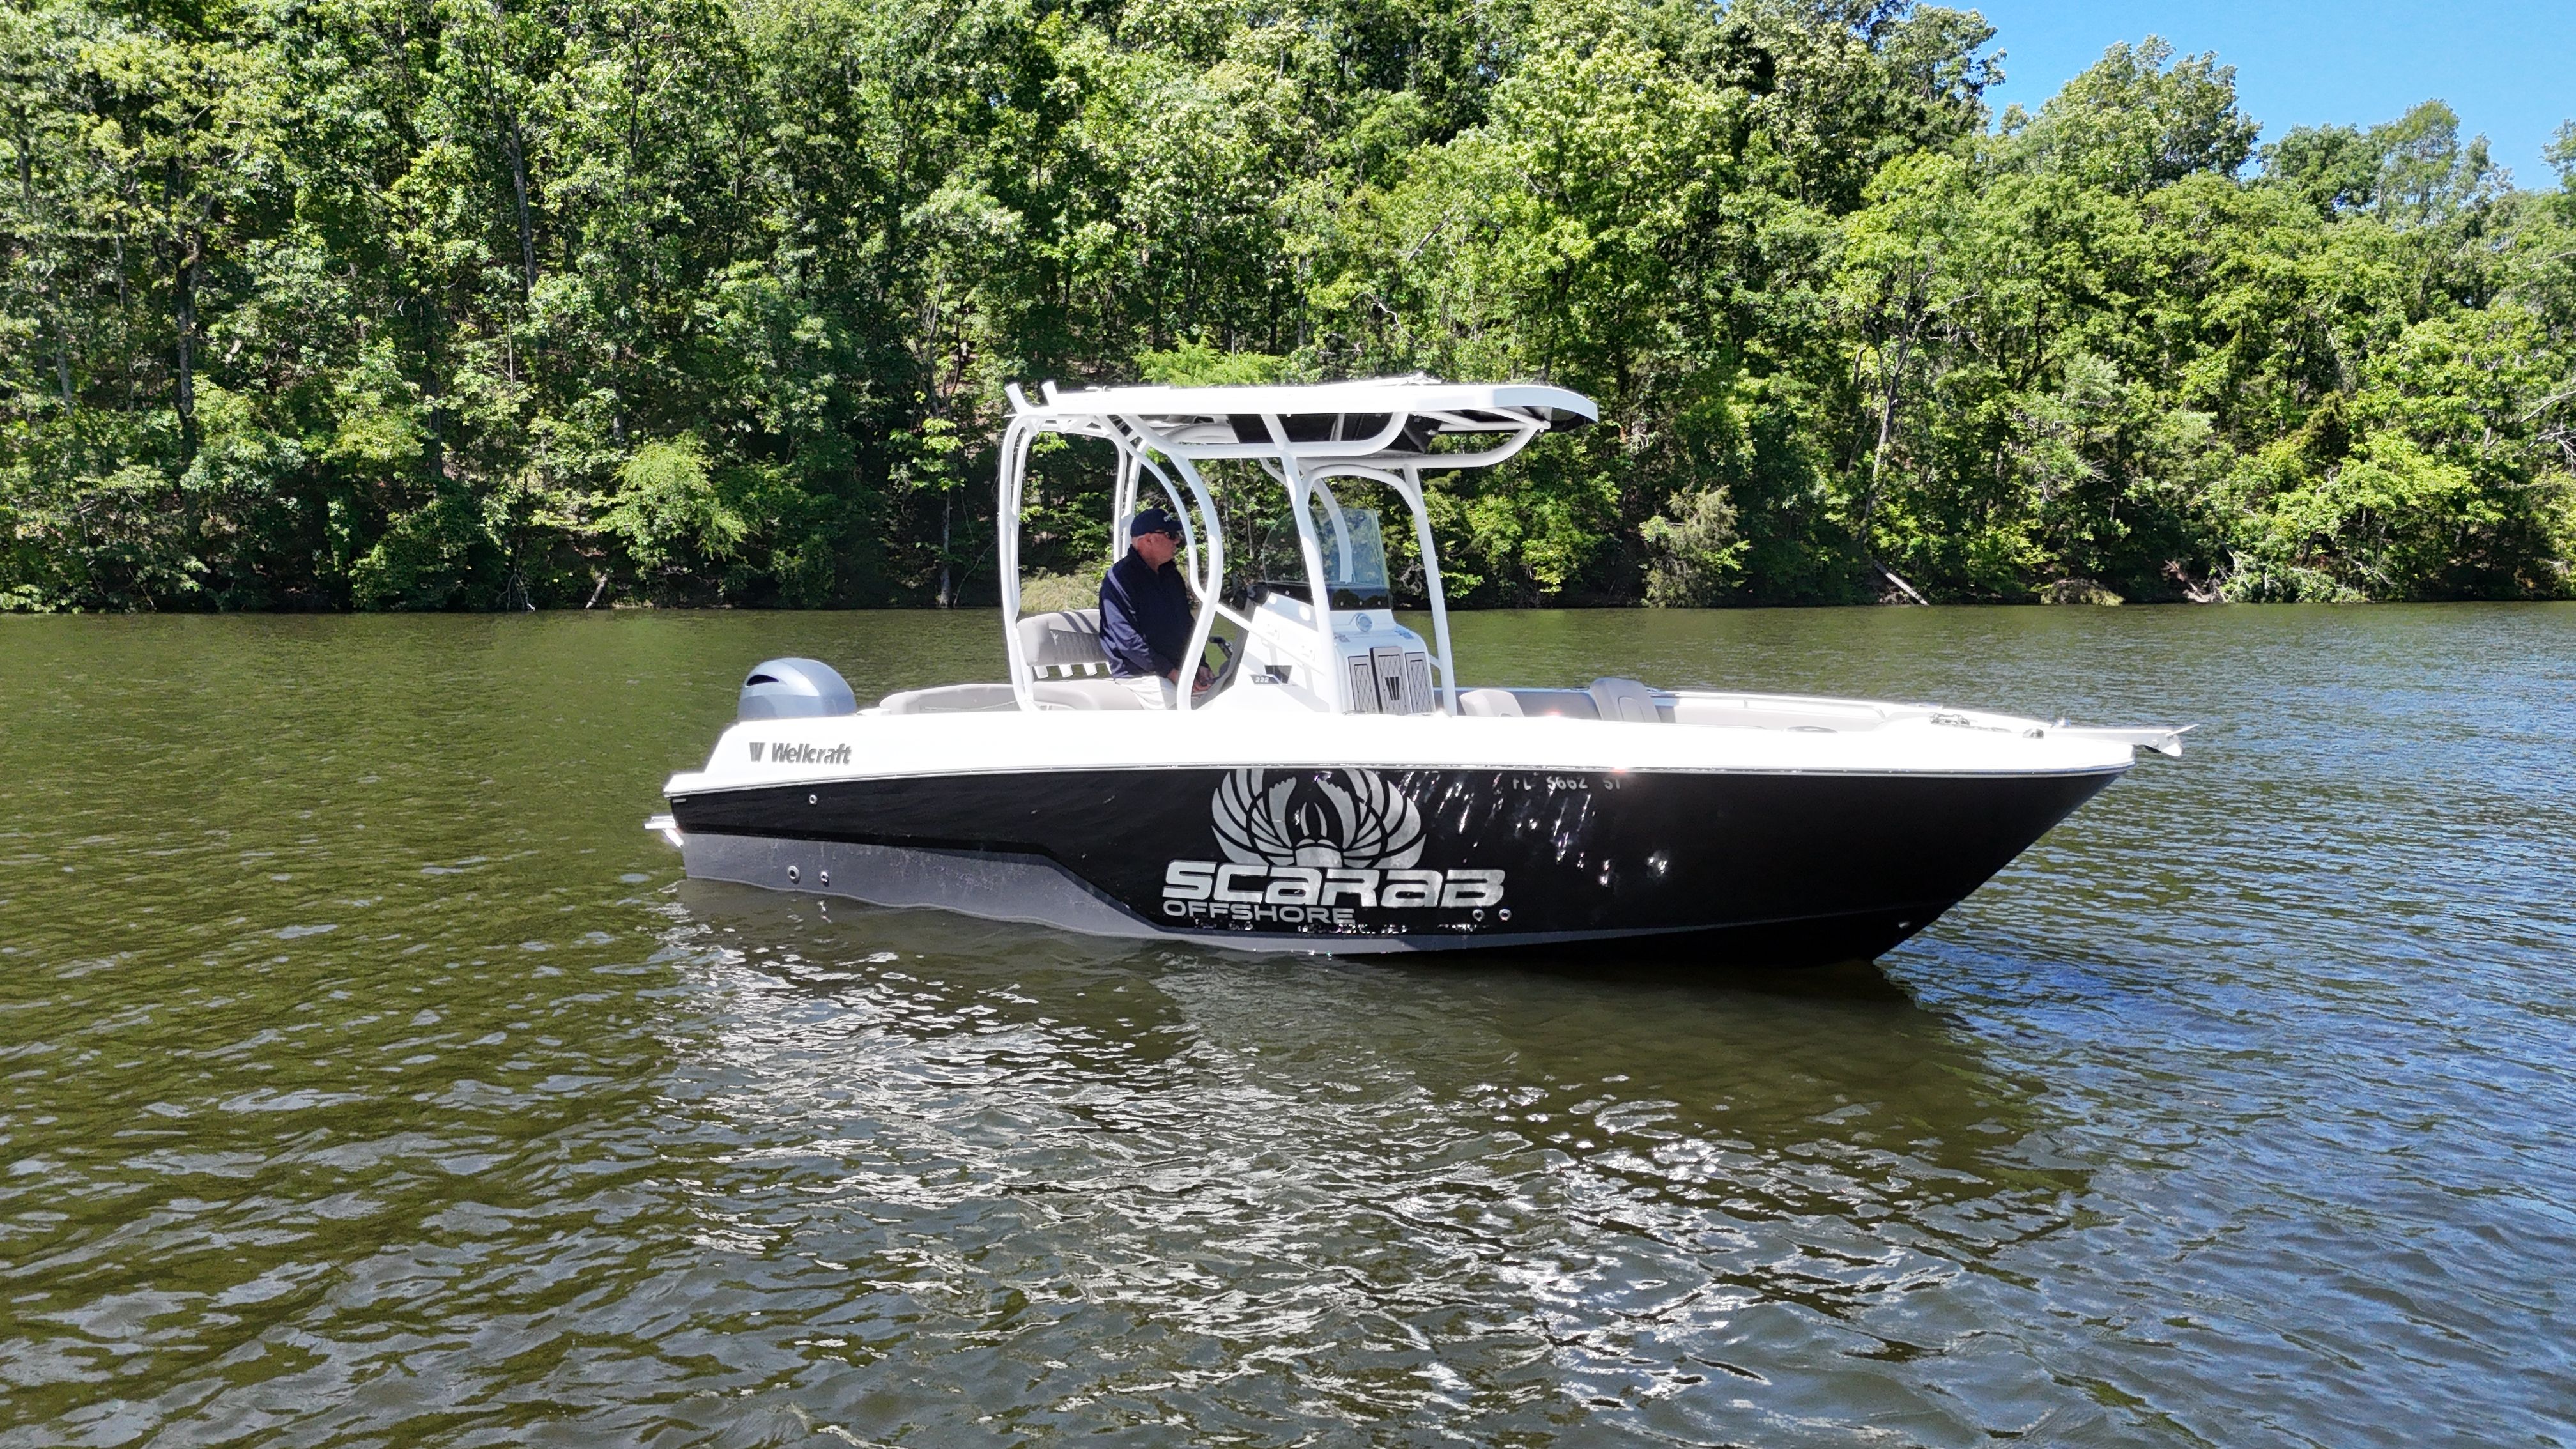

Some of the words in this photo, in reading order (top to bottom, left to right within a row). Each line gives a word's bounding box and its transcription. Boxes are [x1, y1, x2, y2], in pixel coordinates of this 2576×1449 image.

[772, 742, 852, 765] Wellcraft
[1162, 859, 1506, 908] SCARAB
[1162, 900, 1356, 924] OFFSHORE
